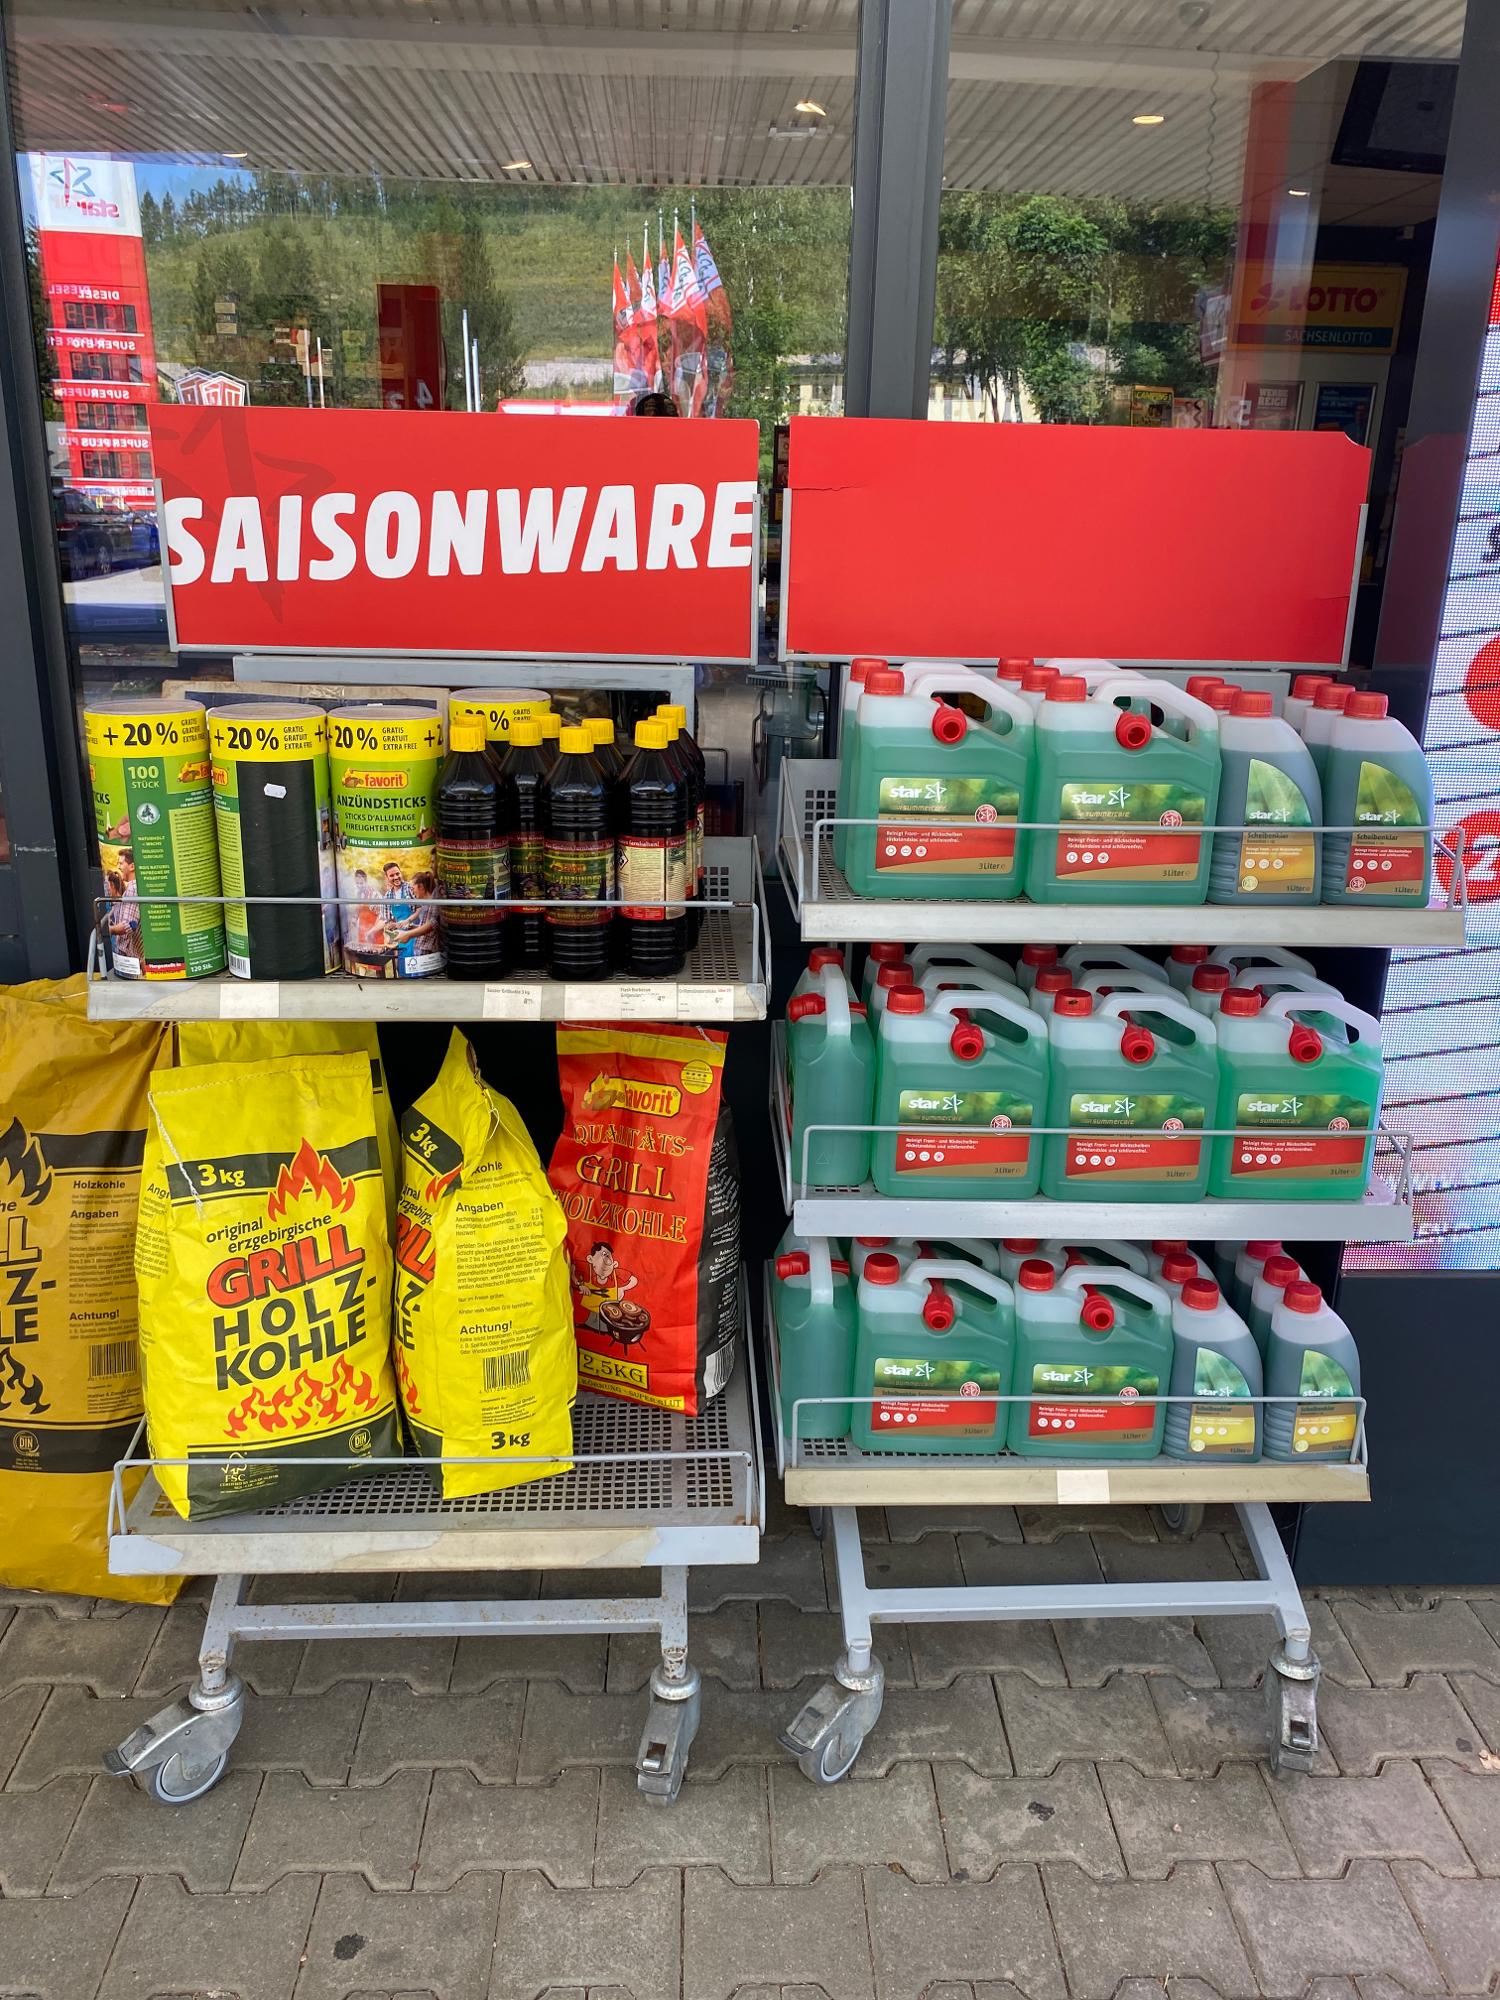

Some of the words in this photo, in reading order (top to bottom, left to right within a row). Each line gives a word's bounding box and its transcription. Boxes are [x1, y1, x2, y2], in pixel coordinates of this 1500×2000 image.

[1289, 287, 1377, 313] LOTTO
[1285, 329, 1373, 343] SACHSENLOTTO
[165, 480, 758, 586] SAISONWARE
[128, 766, 159, 779] 100
[131, 780, 160, 789] STÜCK
[365, 774, 404, 786] favorit
[889, 785, 922, 799] star
[1072, 792, 1105, 805] star
[337, 795, 426, 809] ANZÜNDSTICKS
[368, 813, 416, 821] D'ALLUMAGE
[1250, 811, 1273, 820] star
[1359, 813, 1383, 821] star
[908, 1097, 940, 1109] star
[1080, 1101, 1111, 1113] star
[1247, 1101, 1279, 1112] star
[410, 1122, 430, 1142] 3
[419, 1137, 439, 1159] kg
[198, 1164, 217, 1187] 3
[220, 1168, 246, 1187] kg
[576, 1154, 675, 1202] GRILL
[73, 1180, 125, 1189] Holzkohle
[456, 1201, 503, 1214] Angaben
[70, 1209, 119, 1220] Angaben
[557, 1189, 688, 1244] HOLZKOHLE
[206, 1217, 263, 1244] original
[227, 1214, 332, 1253] erzgebirgische
[207, 1224, 365, 1308] GRILL
[69, 1309, 119, 1320] Achtung!
[213, 1268, 377, 1352] HOLZ-
[460, 1320, 512, 1335] Achtung!
[215, 1306, 367, 1391] KOHLE
[583, 1355, 645, 1385] 2,5KG
[884, 1365, 913, 1376] star
[1041, 1371, 1072, 1382] star
[1197, 1388, 1218, 1396] star
[1302, 1389, 1322, 1397] star
[19, 1436, 33, 1449] DIN
[355, 1433, 366, 1446] DIN
[491, 1431, 505, 1449] 3
[510, 1432, 531, 1447] kg
[225, 1474, 245, 1482] FSC
